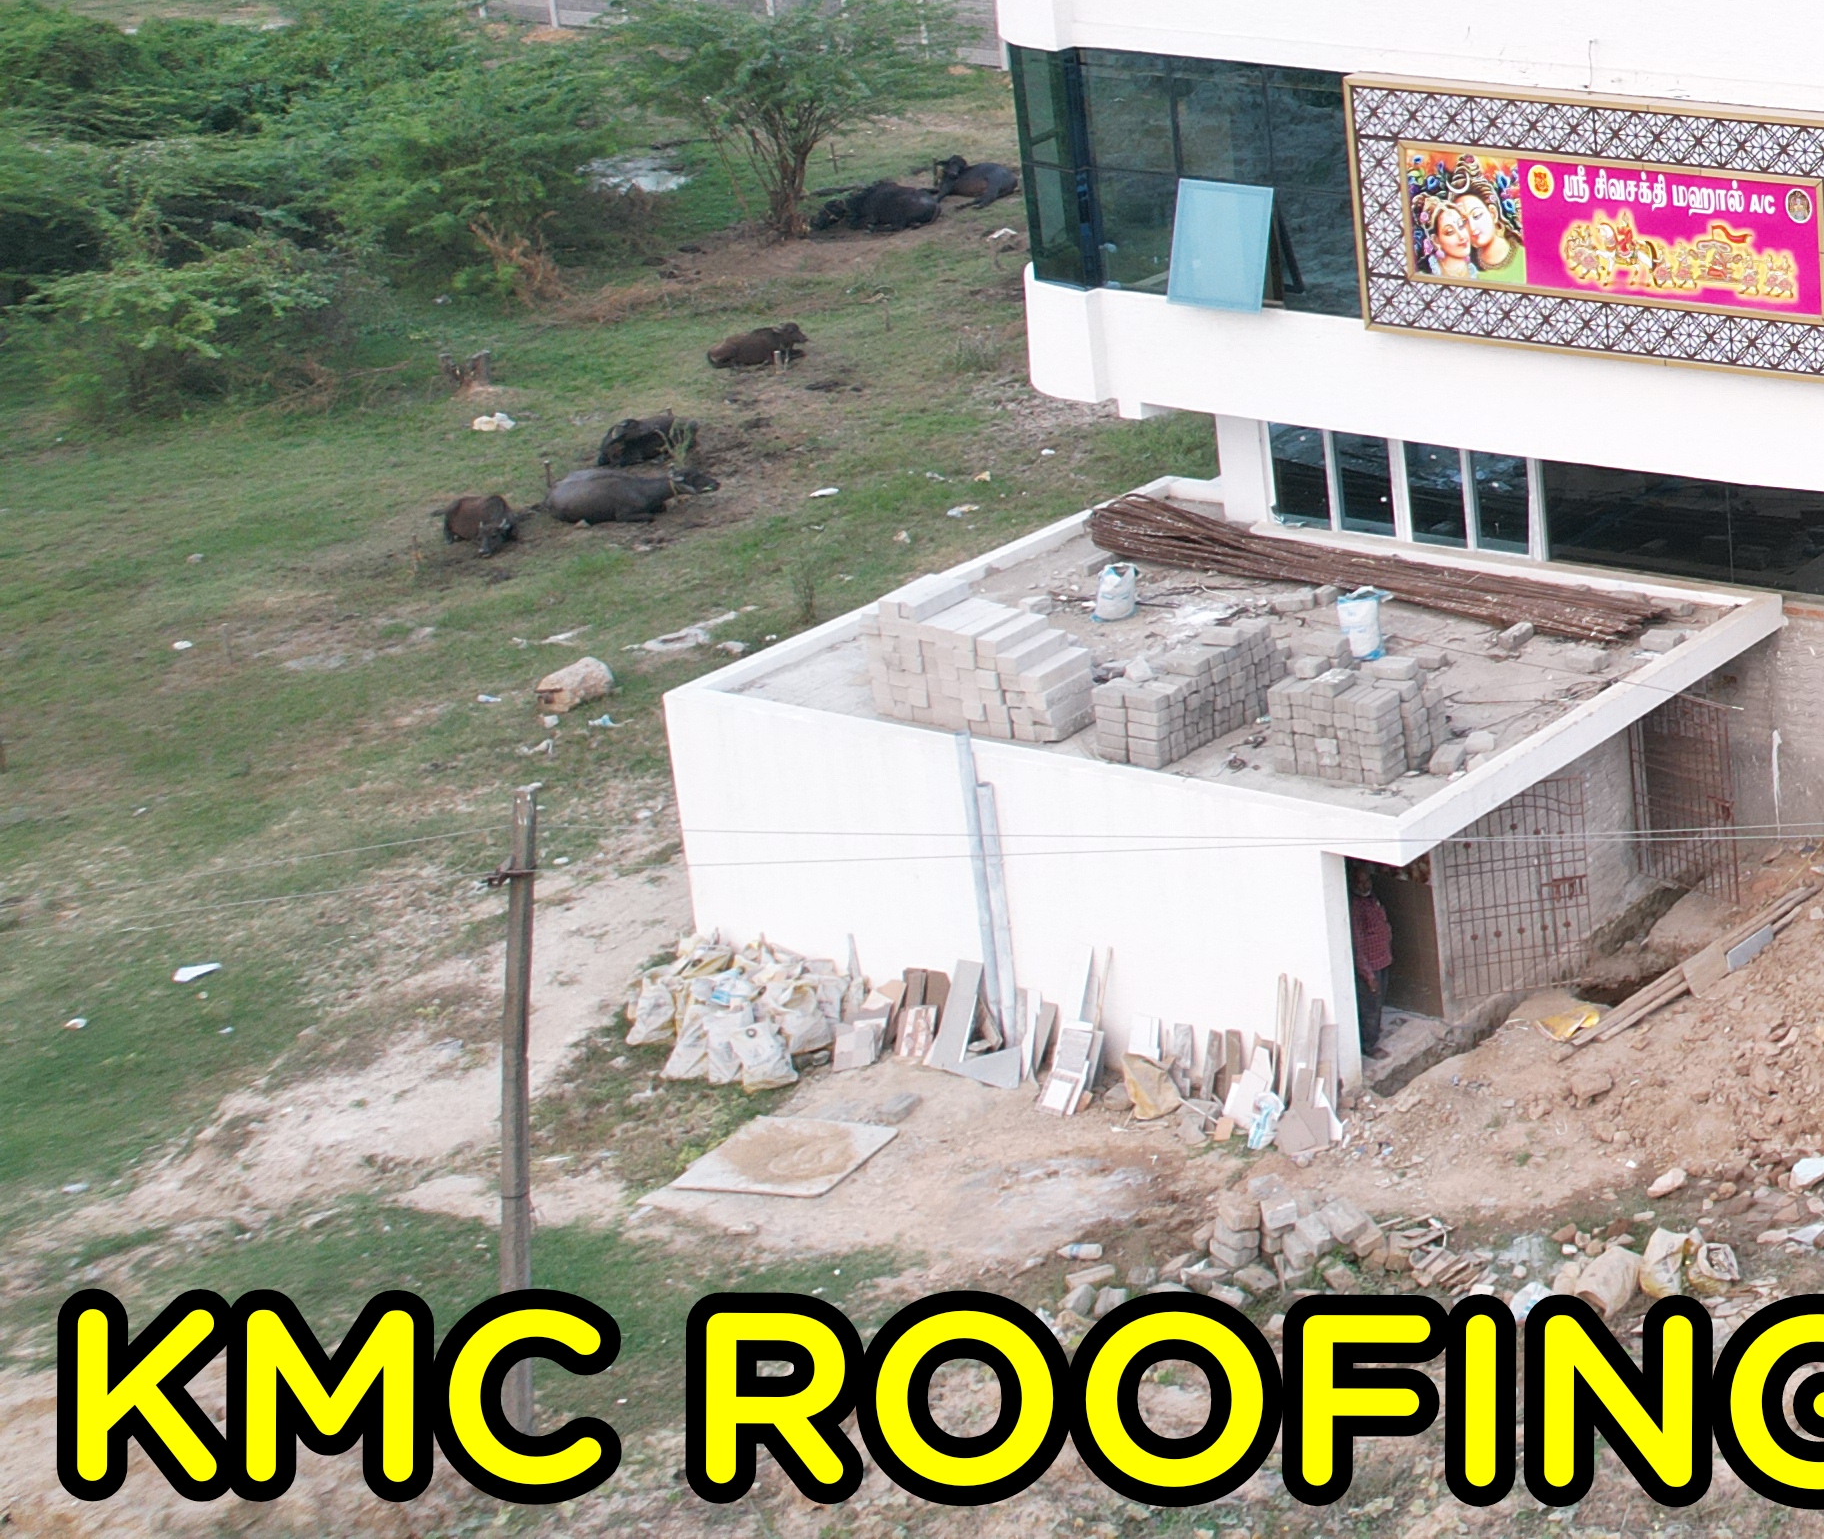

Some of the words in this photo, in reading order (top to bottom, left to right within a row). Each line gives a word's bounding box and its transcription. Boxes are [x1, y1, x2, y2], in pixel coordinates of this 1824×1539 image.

[1594, 168, 1667, 212] சிவசக்தி
[1672, 180, 1745, 217] மஹால்
[1750, 194, 1776, 215] A/C
